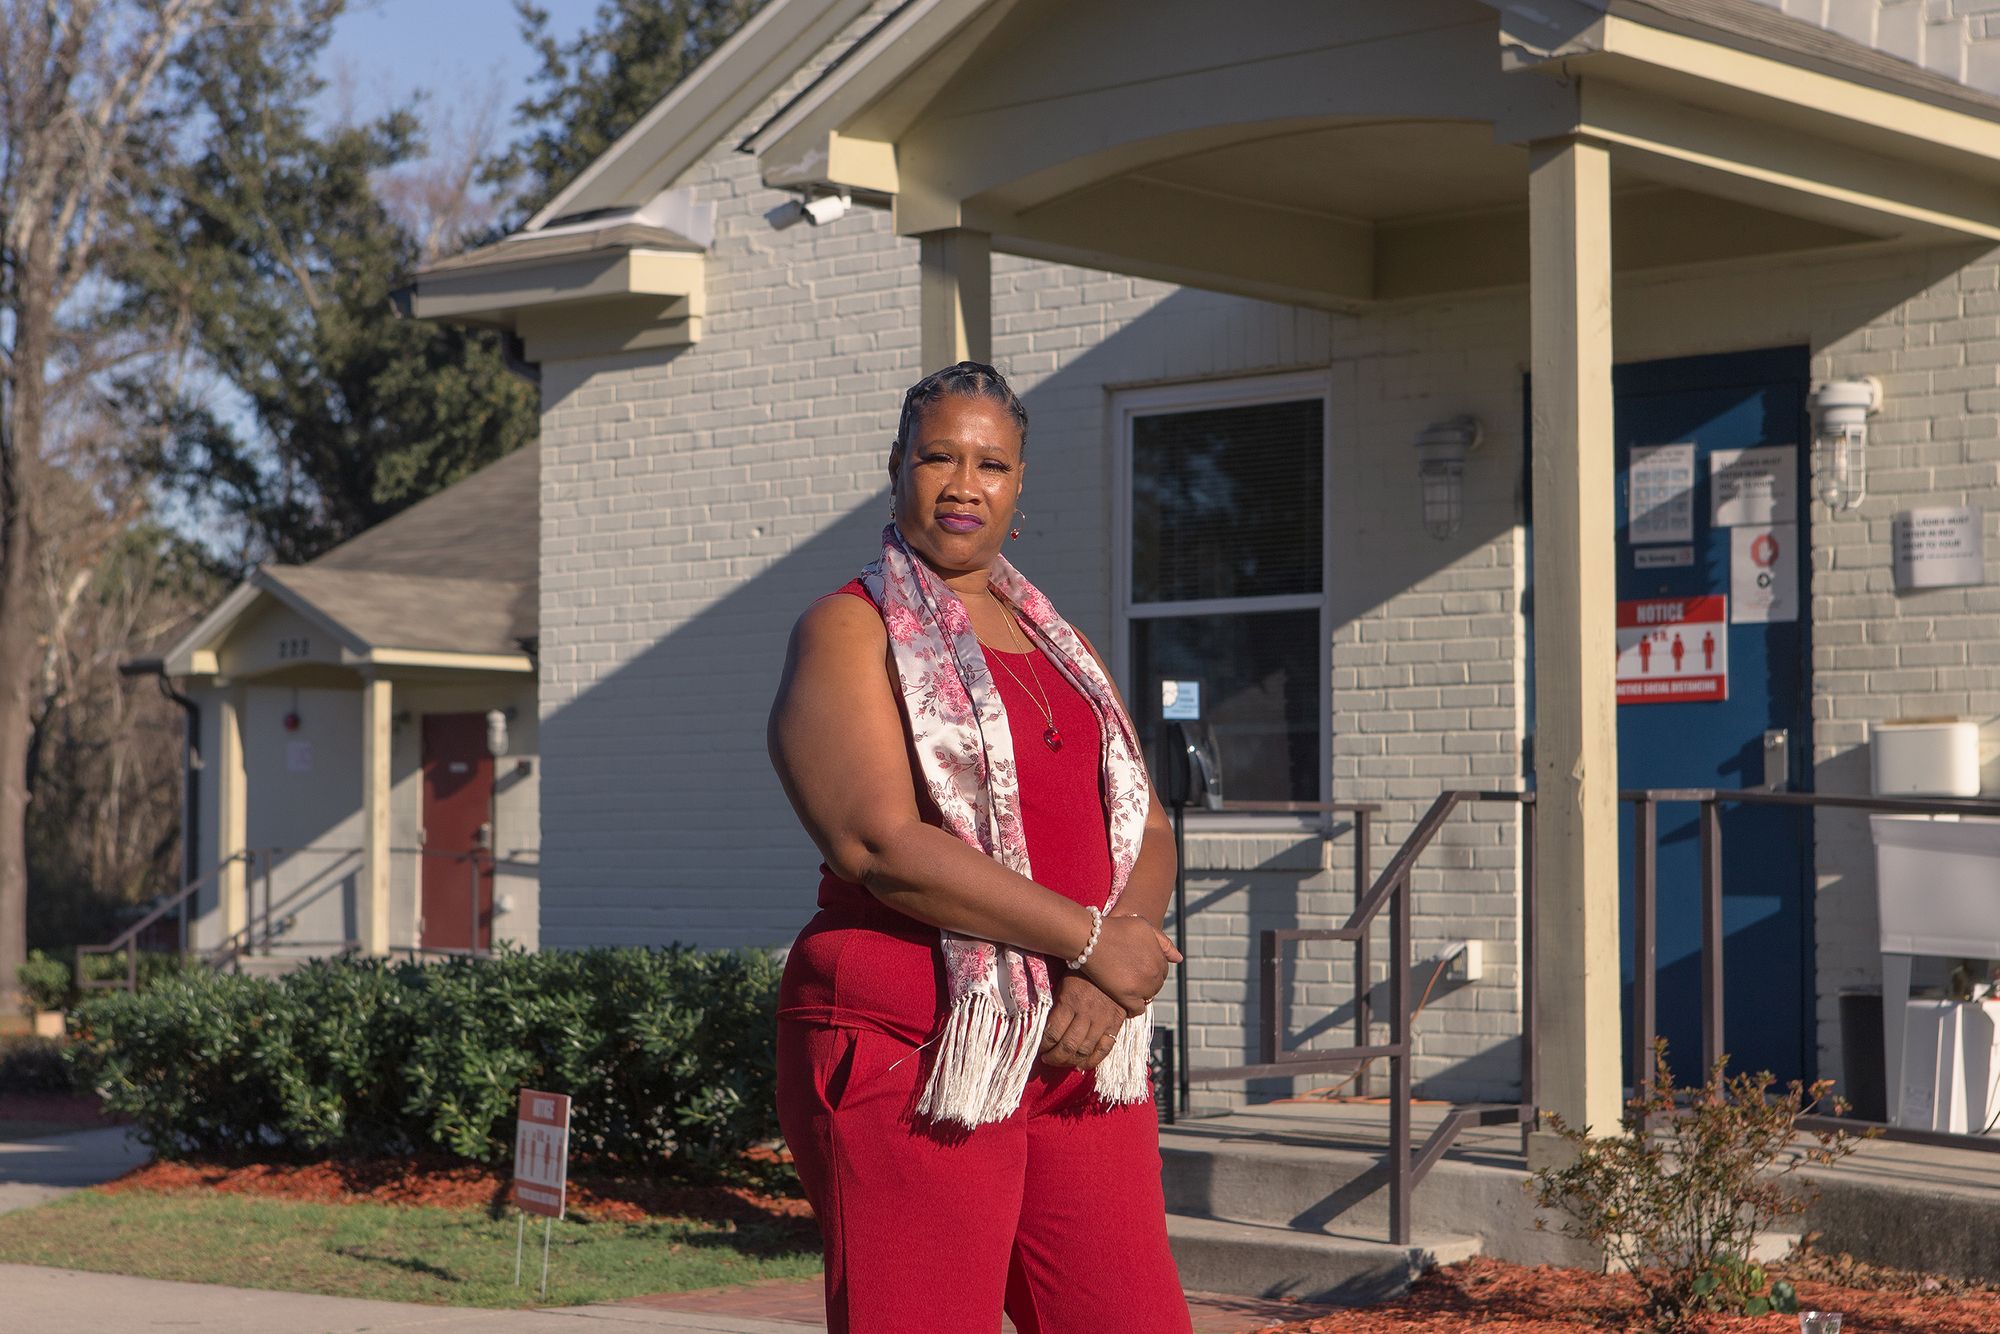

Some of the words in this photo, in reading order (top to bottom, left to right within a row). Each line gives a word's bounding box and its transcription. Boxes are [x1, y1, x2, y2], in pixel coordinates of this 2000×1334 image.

[1636, 602, 1684, 623] NOTICE
[1616, 682, 1643, 696] ACTICE
[1644, 681, 1670, 694] SOCIAL
[1671, 679, 1716, 693] DISTANCING
